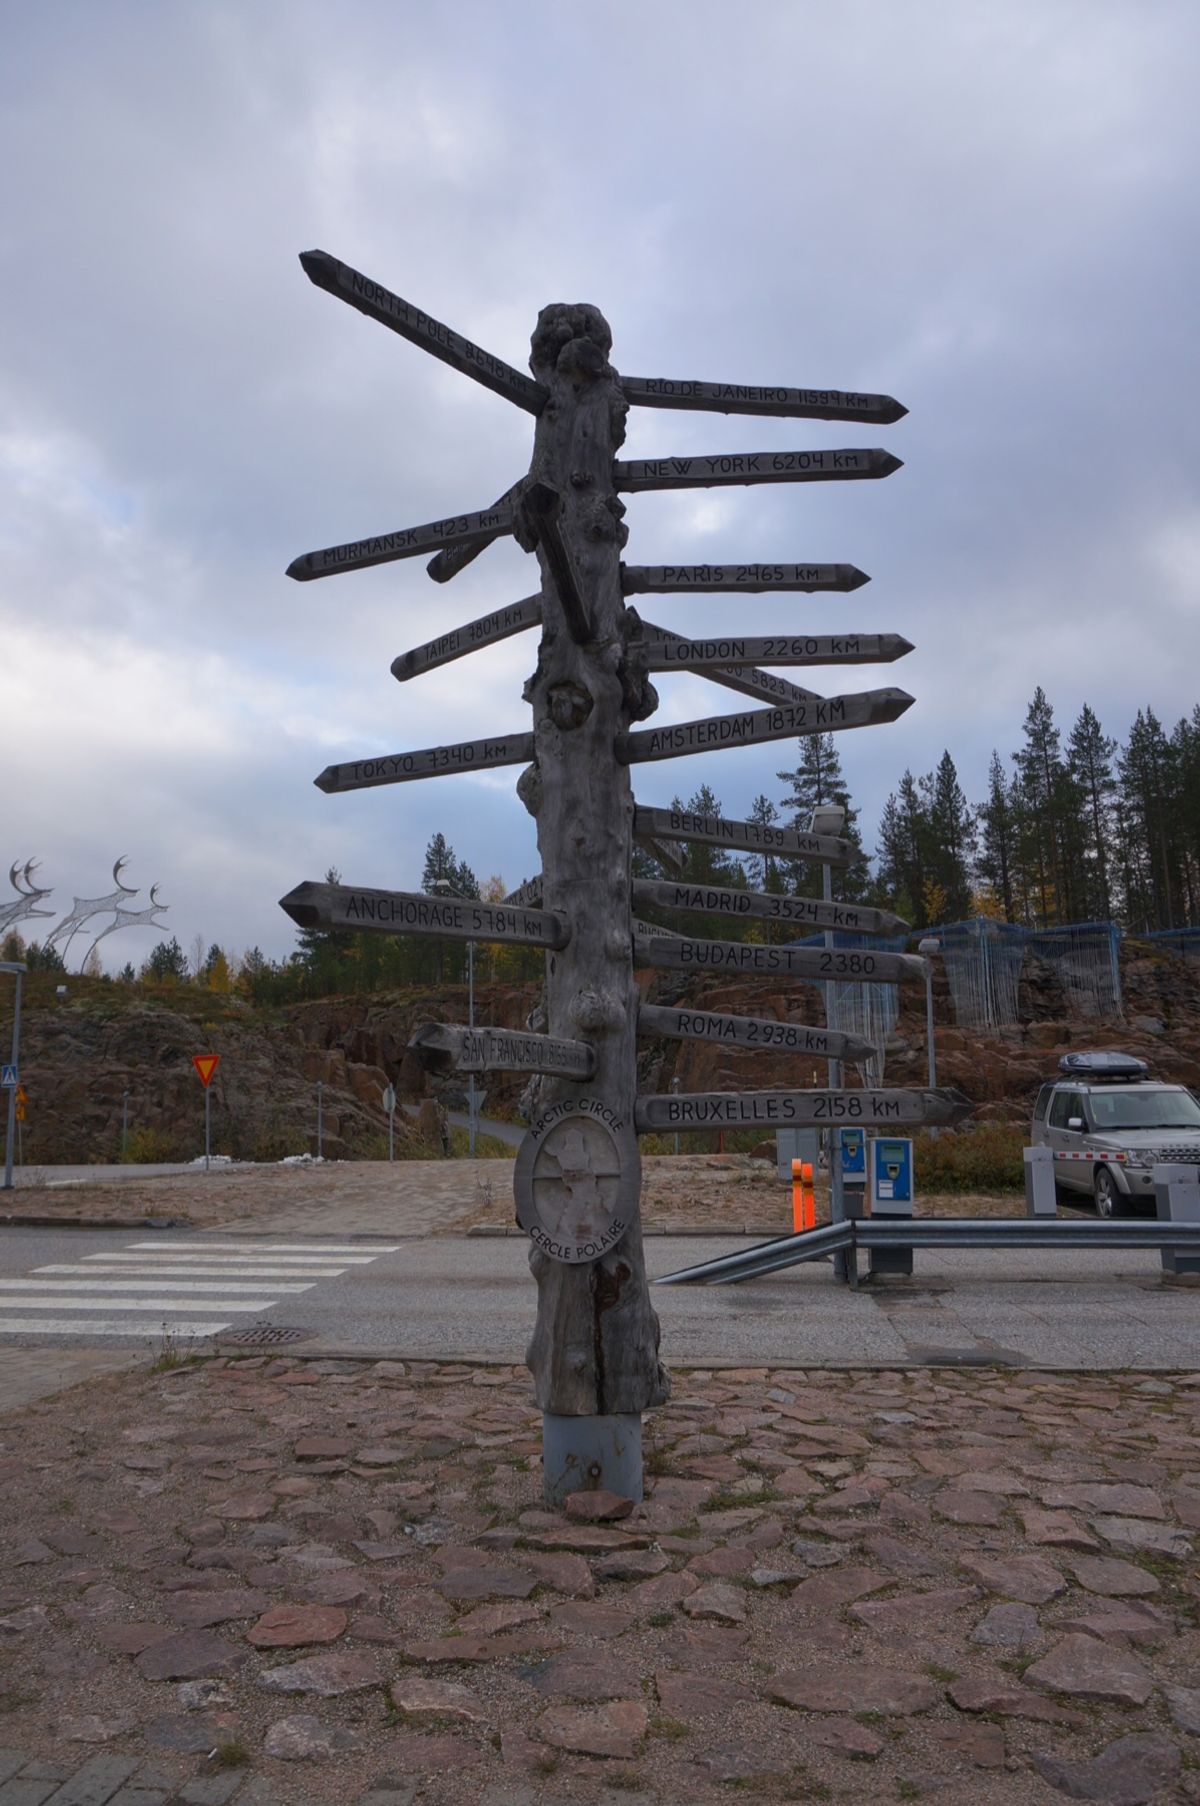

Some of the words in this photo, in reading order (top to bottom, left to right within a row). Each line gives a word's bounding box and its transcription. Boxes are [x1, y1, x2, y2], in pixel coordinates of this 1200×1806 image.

[352, 273, 408, 321] NORTH
[416, 313, 455, 348] POLE
[646, 380, 674, 395] RIO
[682, 382, 703, 396] DE
[712, 385, 788, 402] JANEIRO
[798, 391, 840, 404] 11594
[644, 460, 691, 476] NEW
[706, 457, 760, 472] YORK
[772, 453, 824, 470] 6204
[323, 531, 418, 565] MURMANSK
[432, 517, 469, 537] 423
[662, 566, 724, 582] PARIS
[736, 566, 784, 582] 2465
[424, 633, 460, 662] TAIPEI
[468, 620, 500, 640] 7804
[664, 641, 745, 660] LONDON
[762, 640, 818, 656] 2260
[752, 670, 786, 695] 5823
[650, 716, 754, 752] AMSTERDAM
[766, 708, 806, 730] 1872
[350, 756, 414, 781] TOKYO
[428, 746, 474, 769] 7340
[670, 814, 734, 838] BERLIN
[744, 828, 784, 846] 1789
[346, 896, 463, 928] ANCHORAGE
[472, 910, 516, 932] 5784
[674, 888, 752, 912] MADRID
[768, 899, 818, 922] 3524
[680, 942, 796, 968] BUDAPEST
[820, 953, 875, 974] 2380
[678, 1014, 736, 1038] ROMA
[746, 1022, 798, 1046] 2938
[462, 1035, 486, 1063] SAN
[490, 1038, 543, 1064] FRANCISCO
[531, 1100, 574, 1140] ARCTIC
[578, 1098, 624, 1135] CIRCLE
[668, 1098, 796, 1120] BRUXELLES
[813, 1097, 862, 1118] 2158
[530, 1225, 571, 1259] CERCLE
[576, 1218, 626, 1259] POLAIRE
